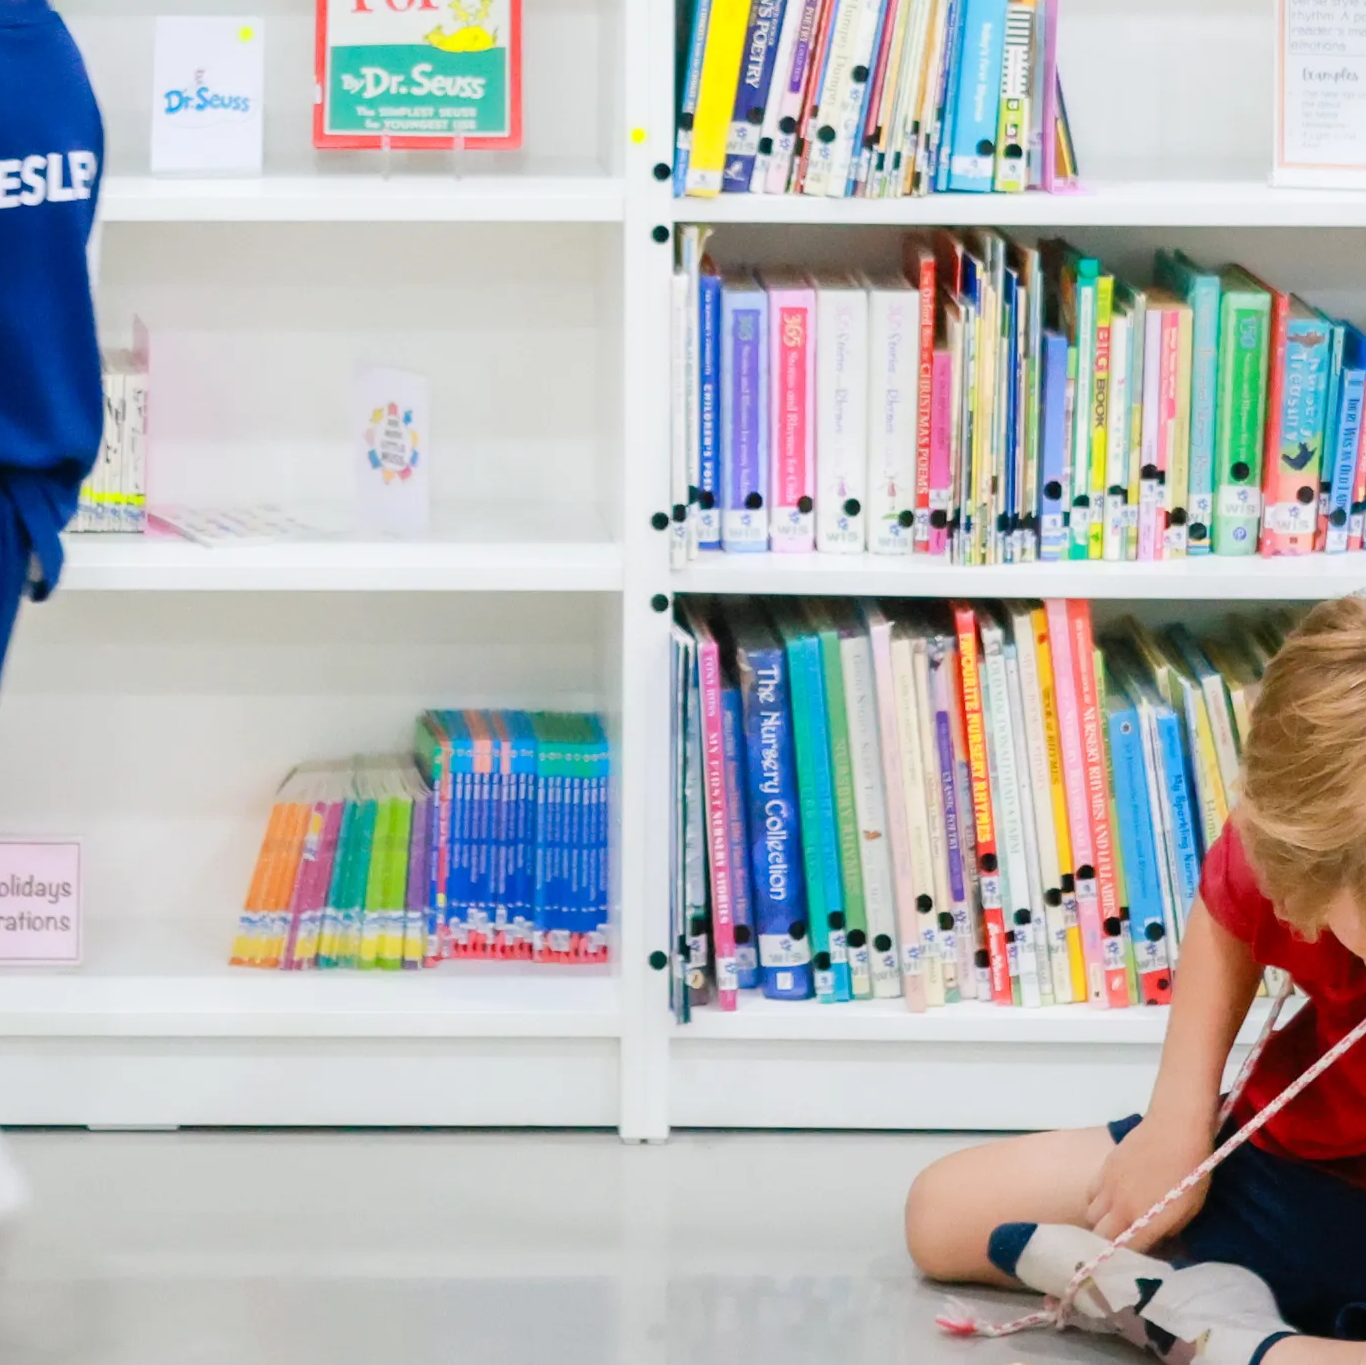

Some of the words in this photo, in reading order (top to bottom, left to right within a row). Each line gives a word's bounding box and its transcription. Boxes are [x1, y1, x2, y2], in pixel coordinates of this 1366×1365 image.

[800, 5, 816, 43] POETRY
[745, 20, 771, 89] POETRY
[341, 75, 364, 95] By
[410, 62, 486, 100] Seuss
[1093, 326, 1110, 372] BIG
[1091, 377, 1106, 429] BOOK
[704, 655, 717, 684] TONY
[756, 664, 779, 703] The
[958, 634, 979, 711] FAVOURITE
[705, 688, 718, 717] ROSS
[707, 733, 719, 753] MY
[758, 711, 784, 794] Nursery
[964, 713, 985, 779] NURSERY
[1081, 706, 1100, 763] NURSERY
[708, 760, 722, 806] FIRST
[941, 770, 955, 805] CLASSIC
[1086, 766, 1105, 820] RHYMES
[711, 810, 725, 867] NURSERY
[944, 809, 958, 850] POETRY
[971, 782, 990, 843] RHYMES
[1092, 821, 1108, 849] AND
[763, 799, 788, 900] Collection
[715, 872, 729, 924] STORIES
[1095, 850, 1115, 919] LULLABIES
